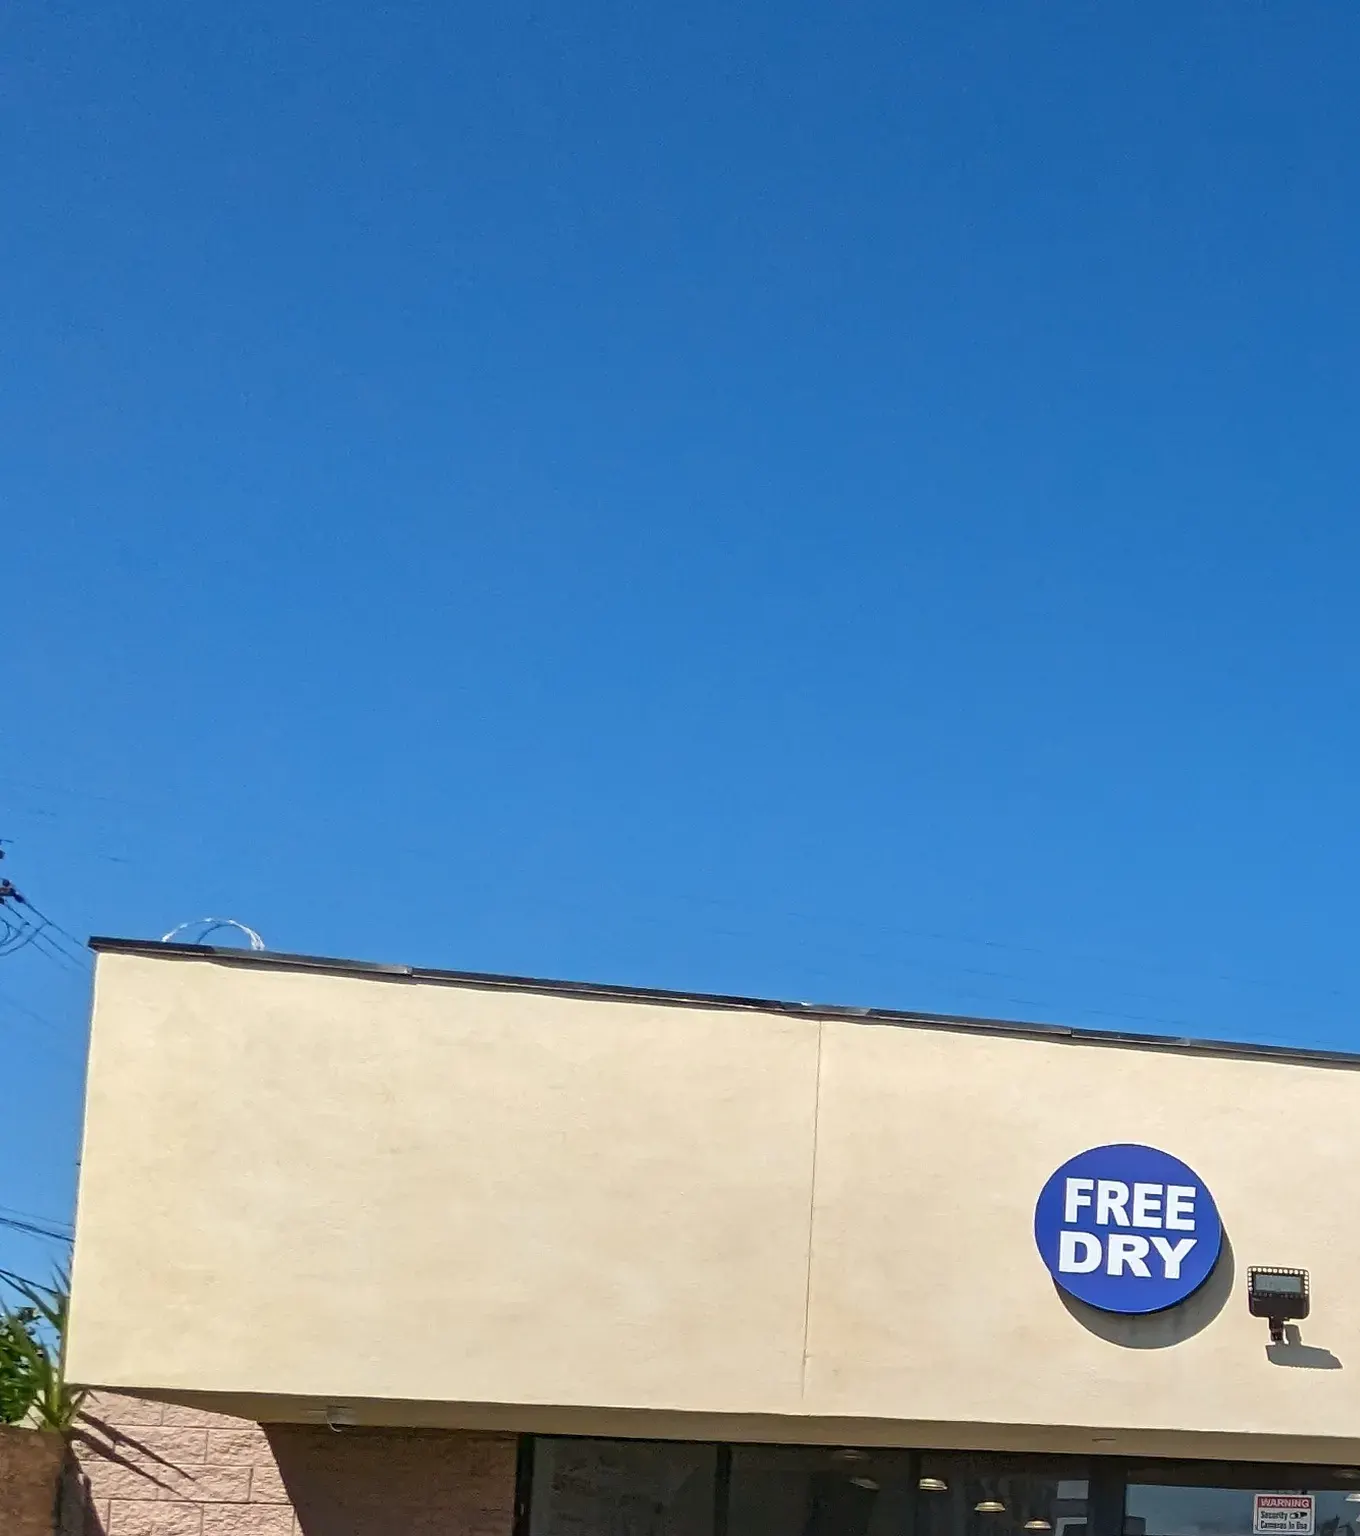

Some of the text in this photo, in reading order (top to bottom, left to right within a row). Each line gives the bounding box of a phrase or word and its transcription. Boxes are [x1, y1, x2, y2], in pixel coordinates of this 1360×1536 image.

[1064, 1177, 1197, 1231] FREE
[1058, 1230, 1198, 1280] DRY
[1260, 1498, 1310, 1508] WARNING
[1260, 1511, 1288, 1521] Security
